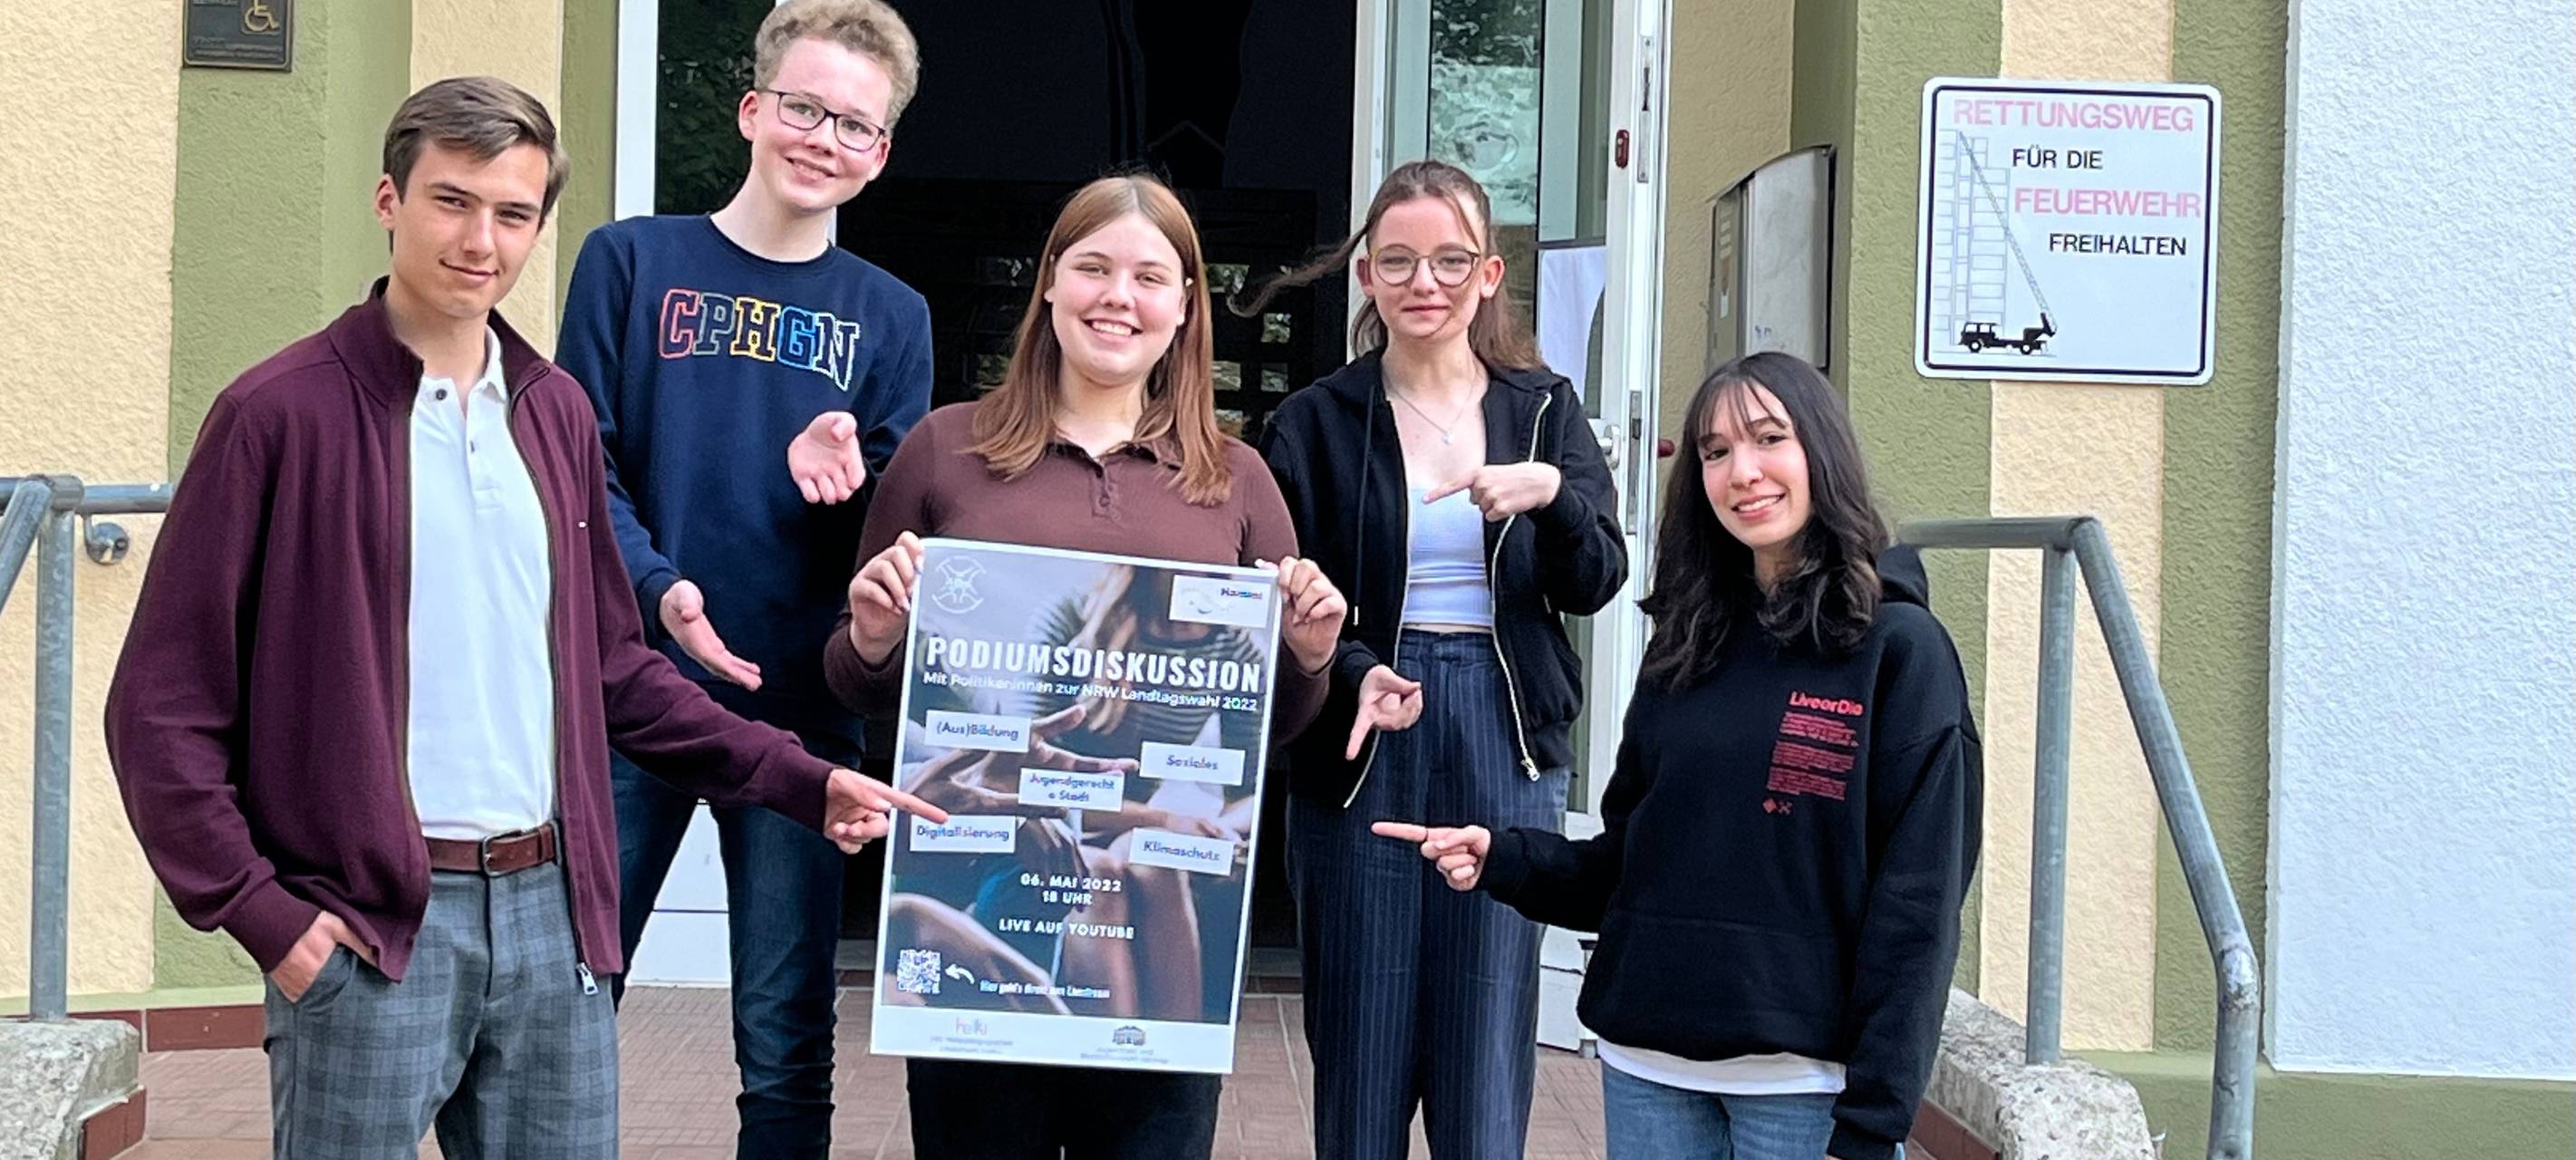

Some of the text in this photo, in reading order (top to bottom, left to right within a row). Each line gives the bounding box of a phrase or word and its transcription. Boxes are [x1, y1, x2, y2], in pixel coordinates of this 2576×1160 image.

[1954, 99, 2194, 131] RETTUNGSWEG
[2012, 145, 2103, 169] FÜR DIE
[2014, 188, 2202, 218] FEUERWEHR
[2049, 233, 2186, 256] FREIHALTEN
[659, 288, 860, 392] CPHGN
[926, 636, 1260, 693] PODIUMSDISKUSSION
[923, 672, 948, 686] Mit
[1056, 683, 1080, 695] zur
[1081, 684, 1120, 701] NRW
[1121, 688, 1220, 708] Landtagswahl
[1221, 697, 1258, 711] 2022
[1167, 755, 1219, 770] Soziales
[916, 825, 1009, 842] Digitalisierung
[1143, 841, 1220, 861] Klimaschutz
[1020, 873, 1122, 892] 06. MAI 2022
[1062, 892, 1093, 905] UHR
[999, 918, 1134, 940] LIVE AUF YOUTUBE
